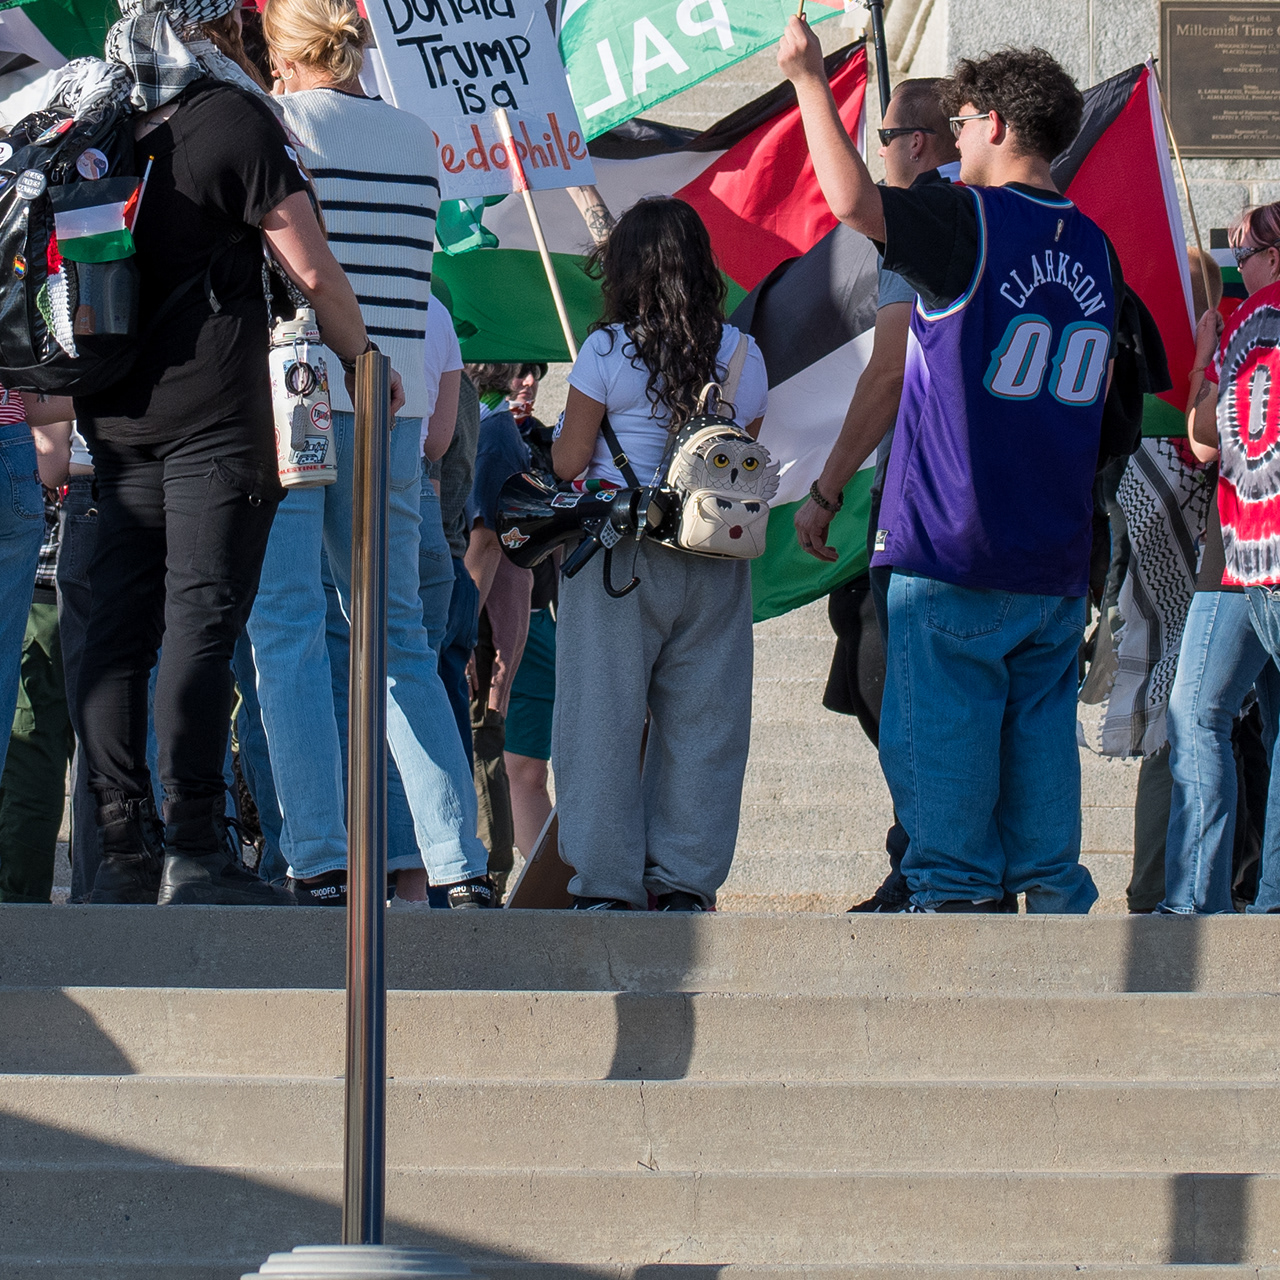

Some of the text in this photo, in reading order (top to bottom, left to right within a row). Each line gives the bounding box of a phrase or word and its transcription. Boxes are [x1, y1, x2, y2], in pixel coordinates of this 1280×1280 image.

[1176, 24, 1239, 36] Millennial
[1241, 24, 1274, 36] Time
[452, 78, 518, 115] is a
[431, 112, 587, 174] edohile
[1000, 250, 1106, 317] CLARKSON
[983, 313, 1110, 407] 00
